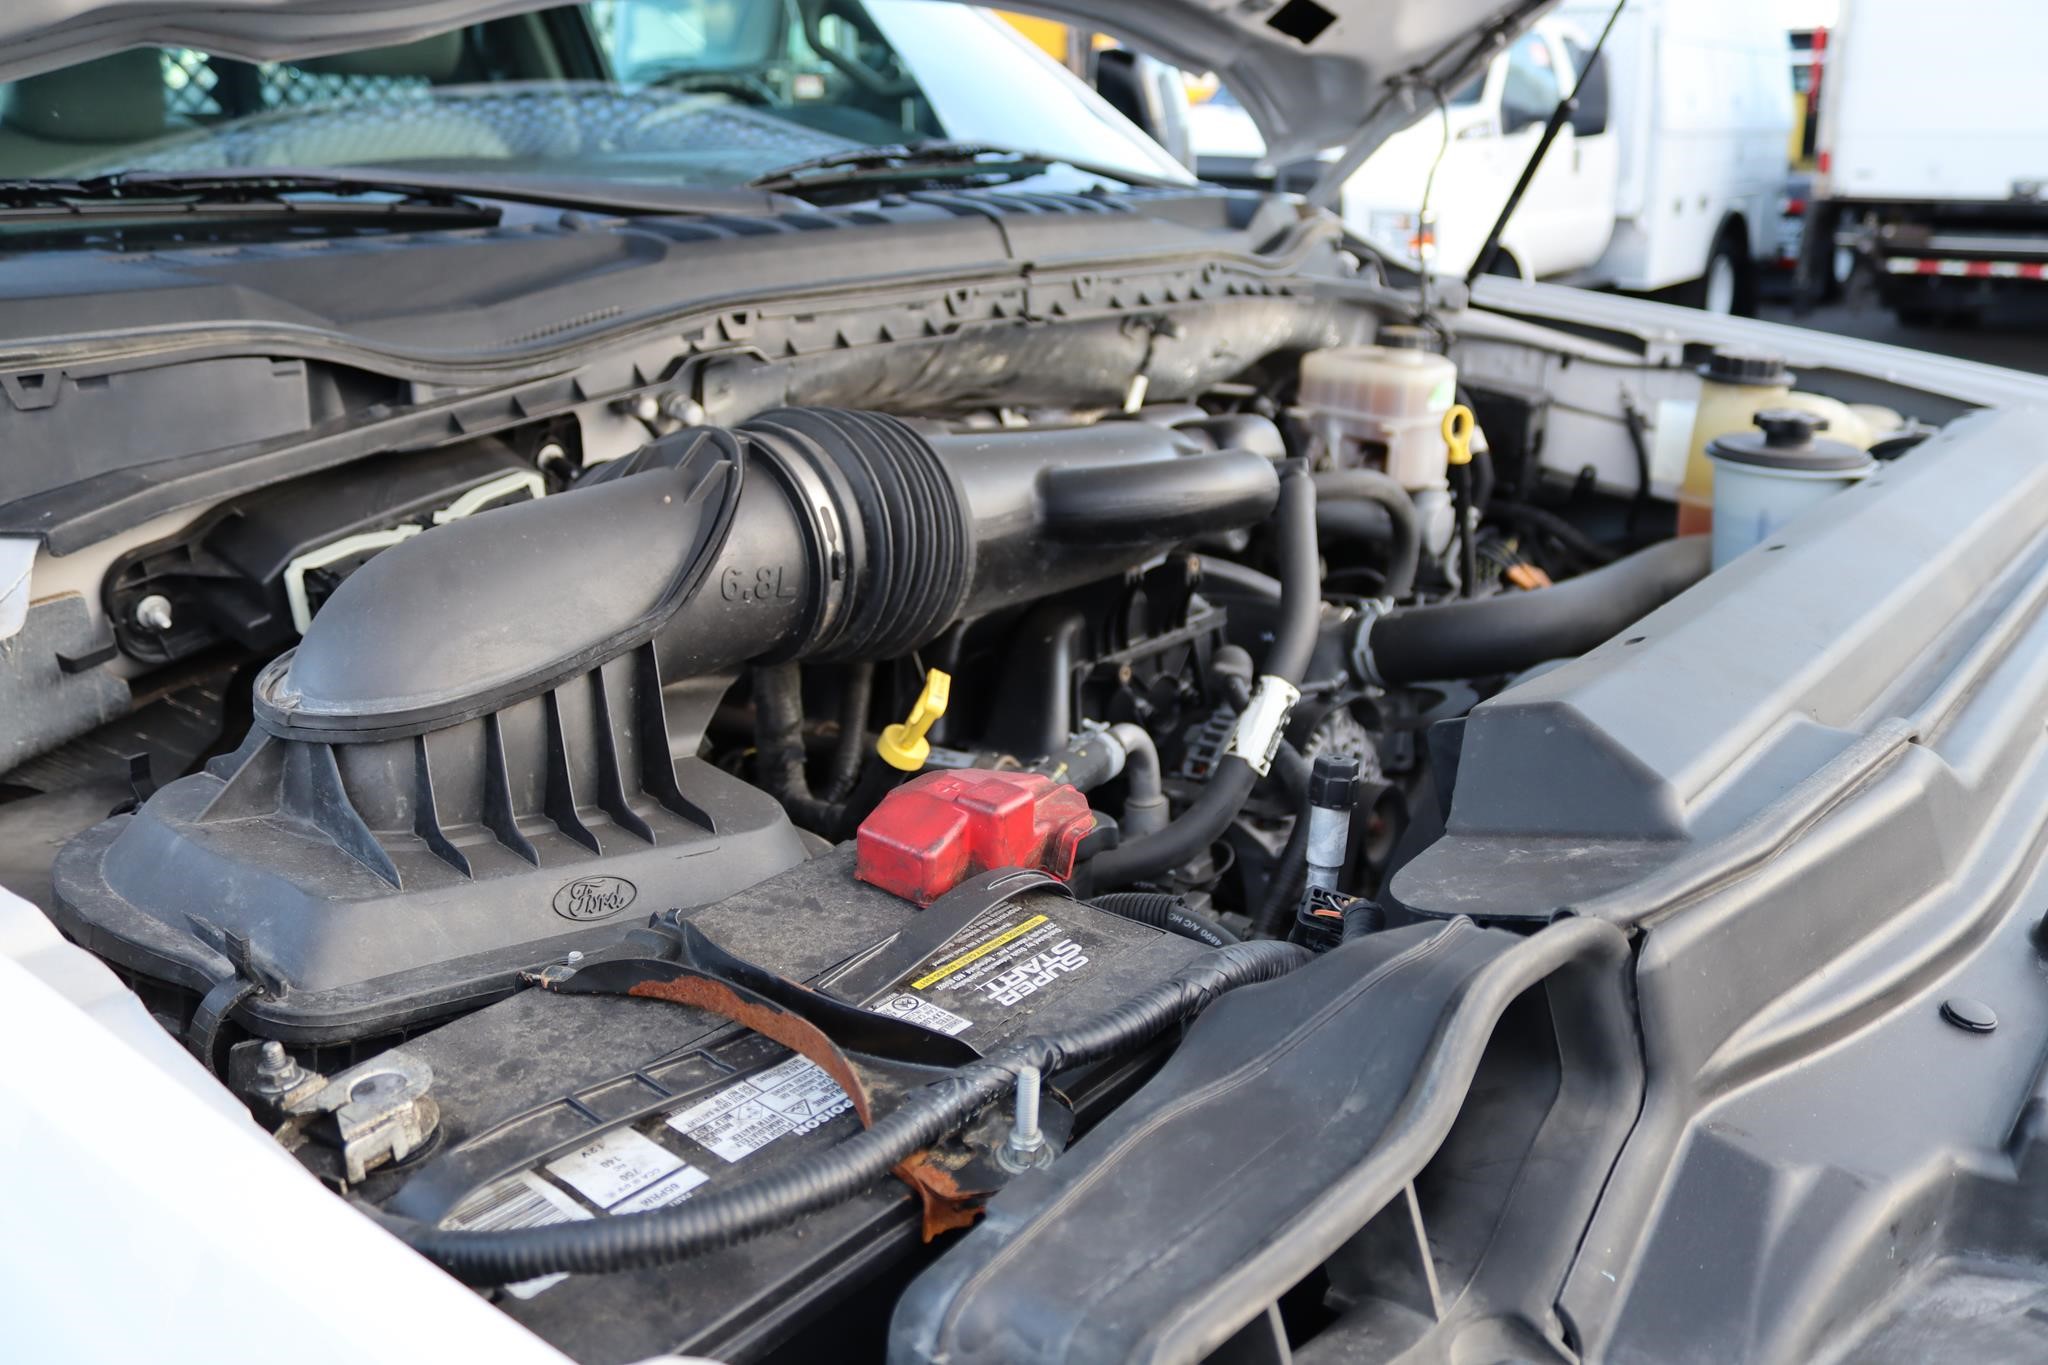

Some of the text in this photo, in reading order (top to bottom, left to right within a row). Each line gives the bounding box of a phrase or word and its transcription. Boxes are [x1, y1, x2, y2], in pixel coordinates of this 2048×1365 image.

[721, 566, 798, 601] 6.8L
[568, 879, 624, 917] Ford
[1200, 928, 1223, 947] 4890
[987, 939, 1082, 1000] START
[996, 954, 1088, 1006] SUPER
[684, 1110, 716, 1128] BATTERY
[710, 1113, 735, 1126] HELP
[728, 1113, 779, 1141] WITH WATER
[793, 1100, 854, 1136] POISON
[694, 1122, 735, 1144] MEDICAL
[704, 1136, 723, 1147] GET
[732, 1118, 787, 1147] IMMEDIATELY
[746, 1122, 794, 1149] FLUSH EYES
[580, 1142, 609, 1157] 12V
[598, 1155, 623, 1168] 140
[617, 1167, 641, 1181] 750
